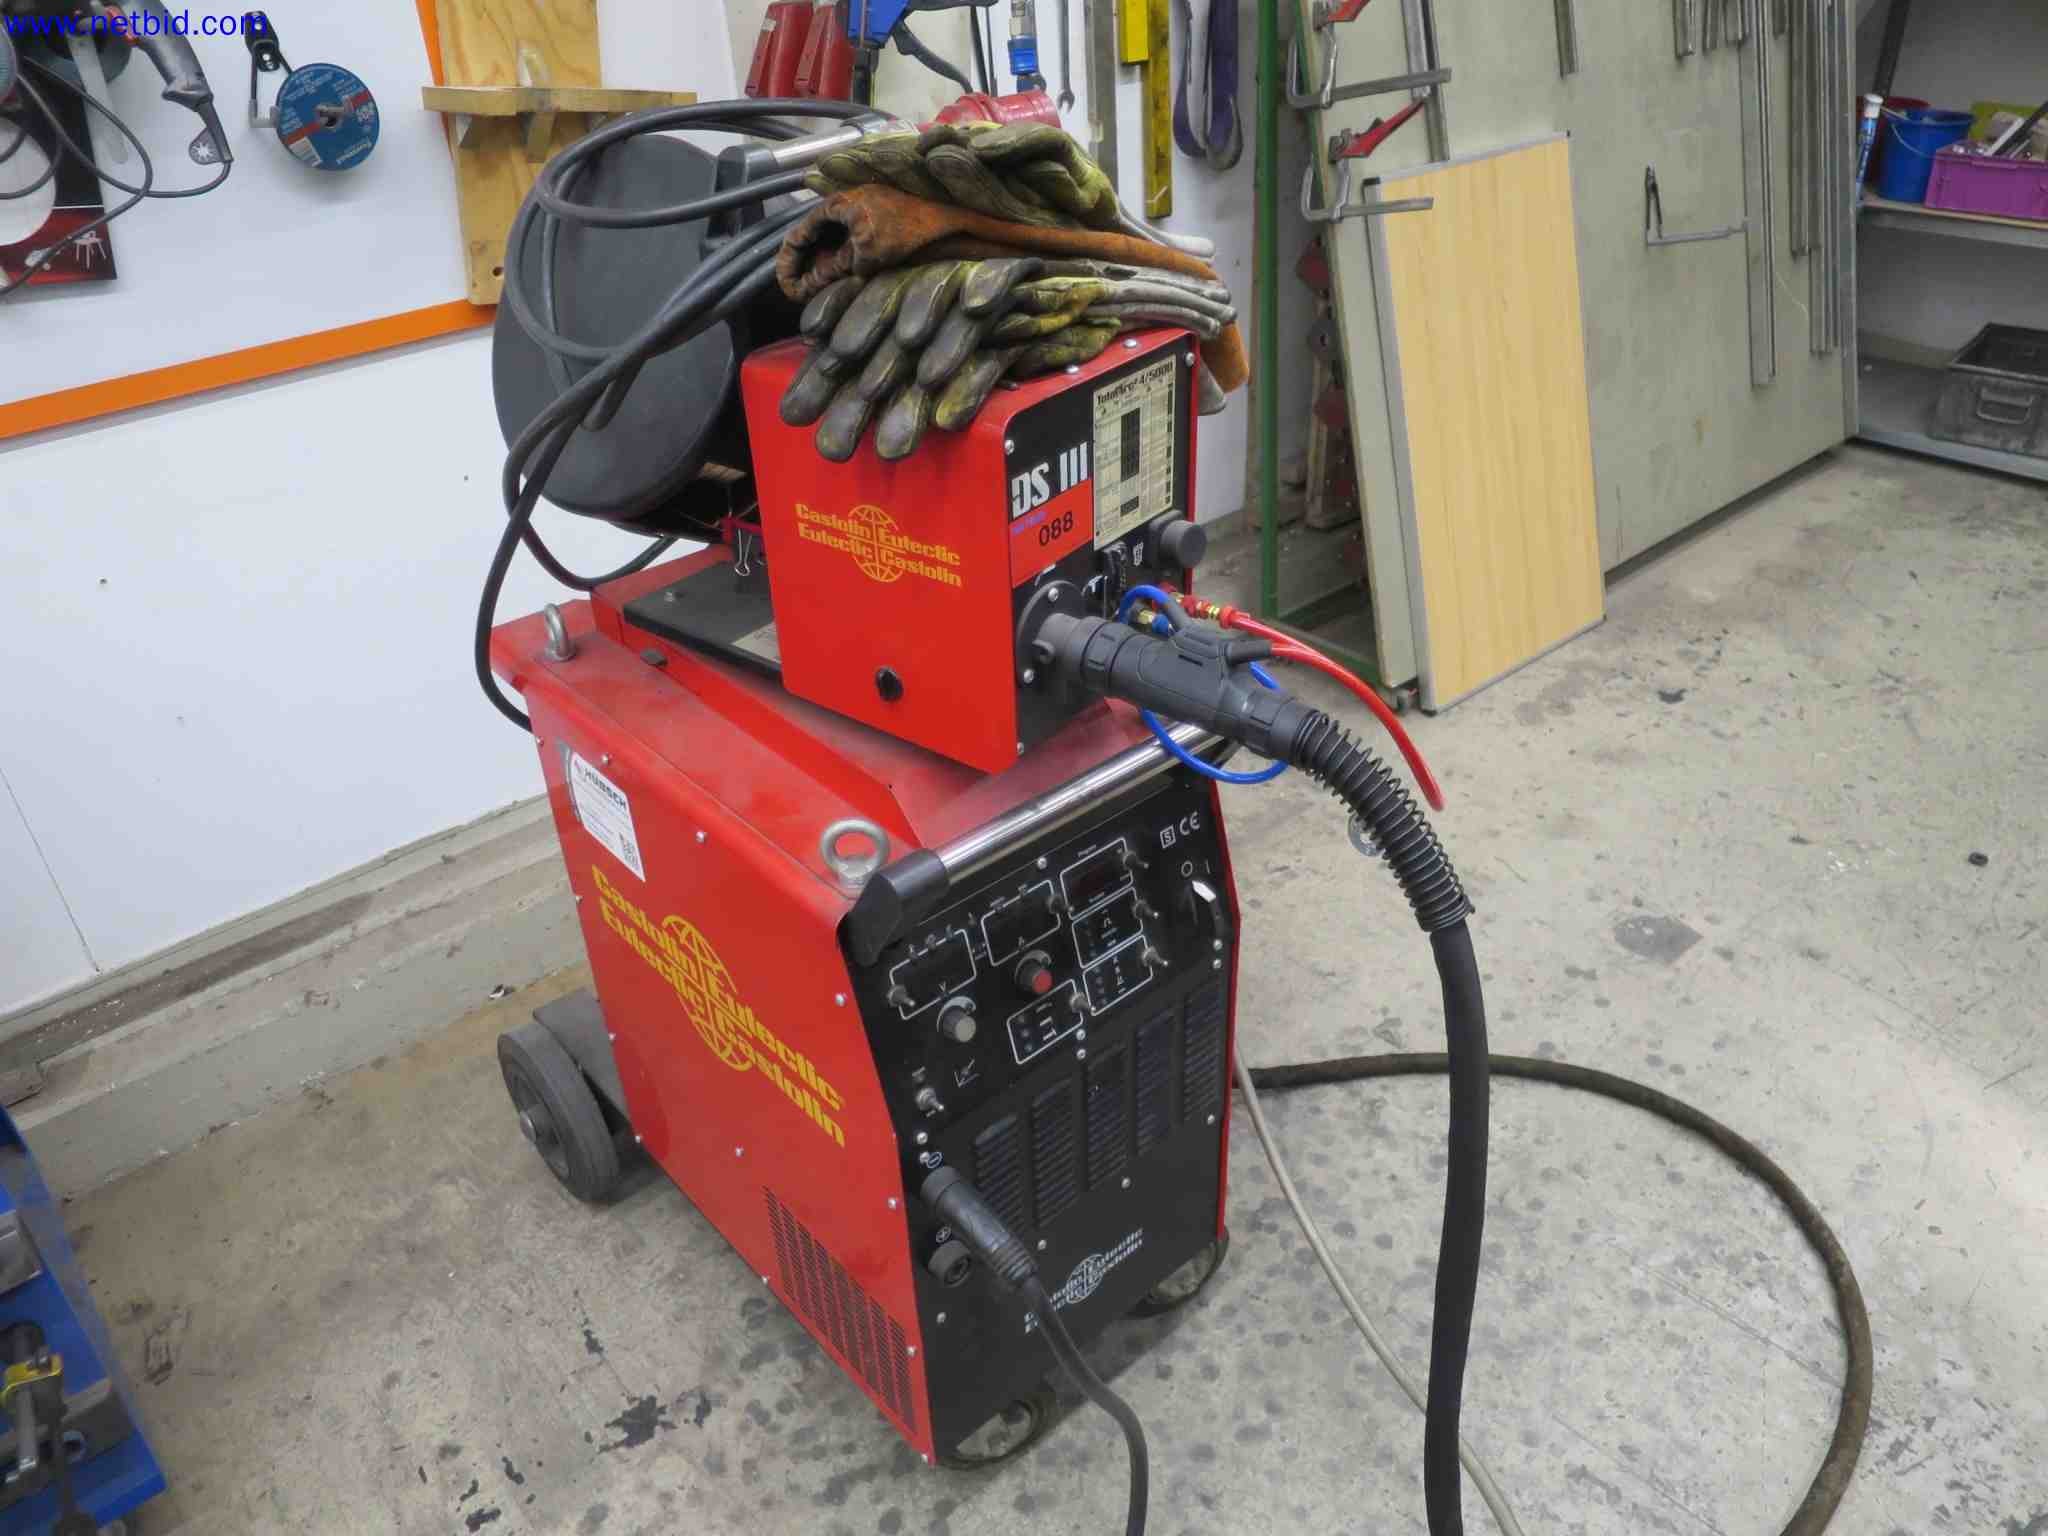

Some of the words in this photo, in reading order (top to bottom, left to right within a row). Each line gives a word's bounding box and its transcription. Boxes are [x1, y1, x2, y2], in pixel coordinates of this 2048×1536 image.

[1011, 462, 1050, 520] DS
[1059, 441, 1089, 492] III
[795, 503, 872, 538] Castolin
[878, 527, 961, 566] Eutectic
[798, 522, 874, 557] Eutectic
[880, 550, 962, 587] Castolin
[1039, 511, 1074, 546] 088
